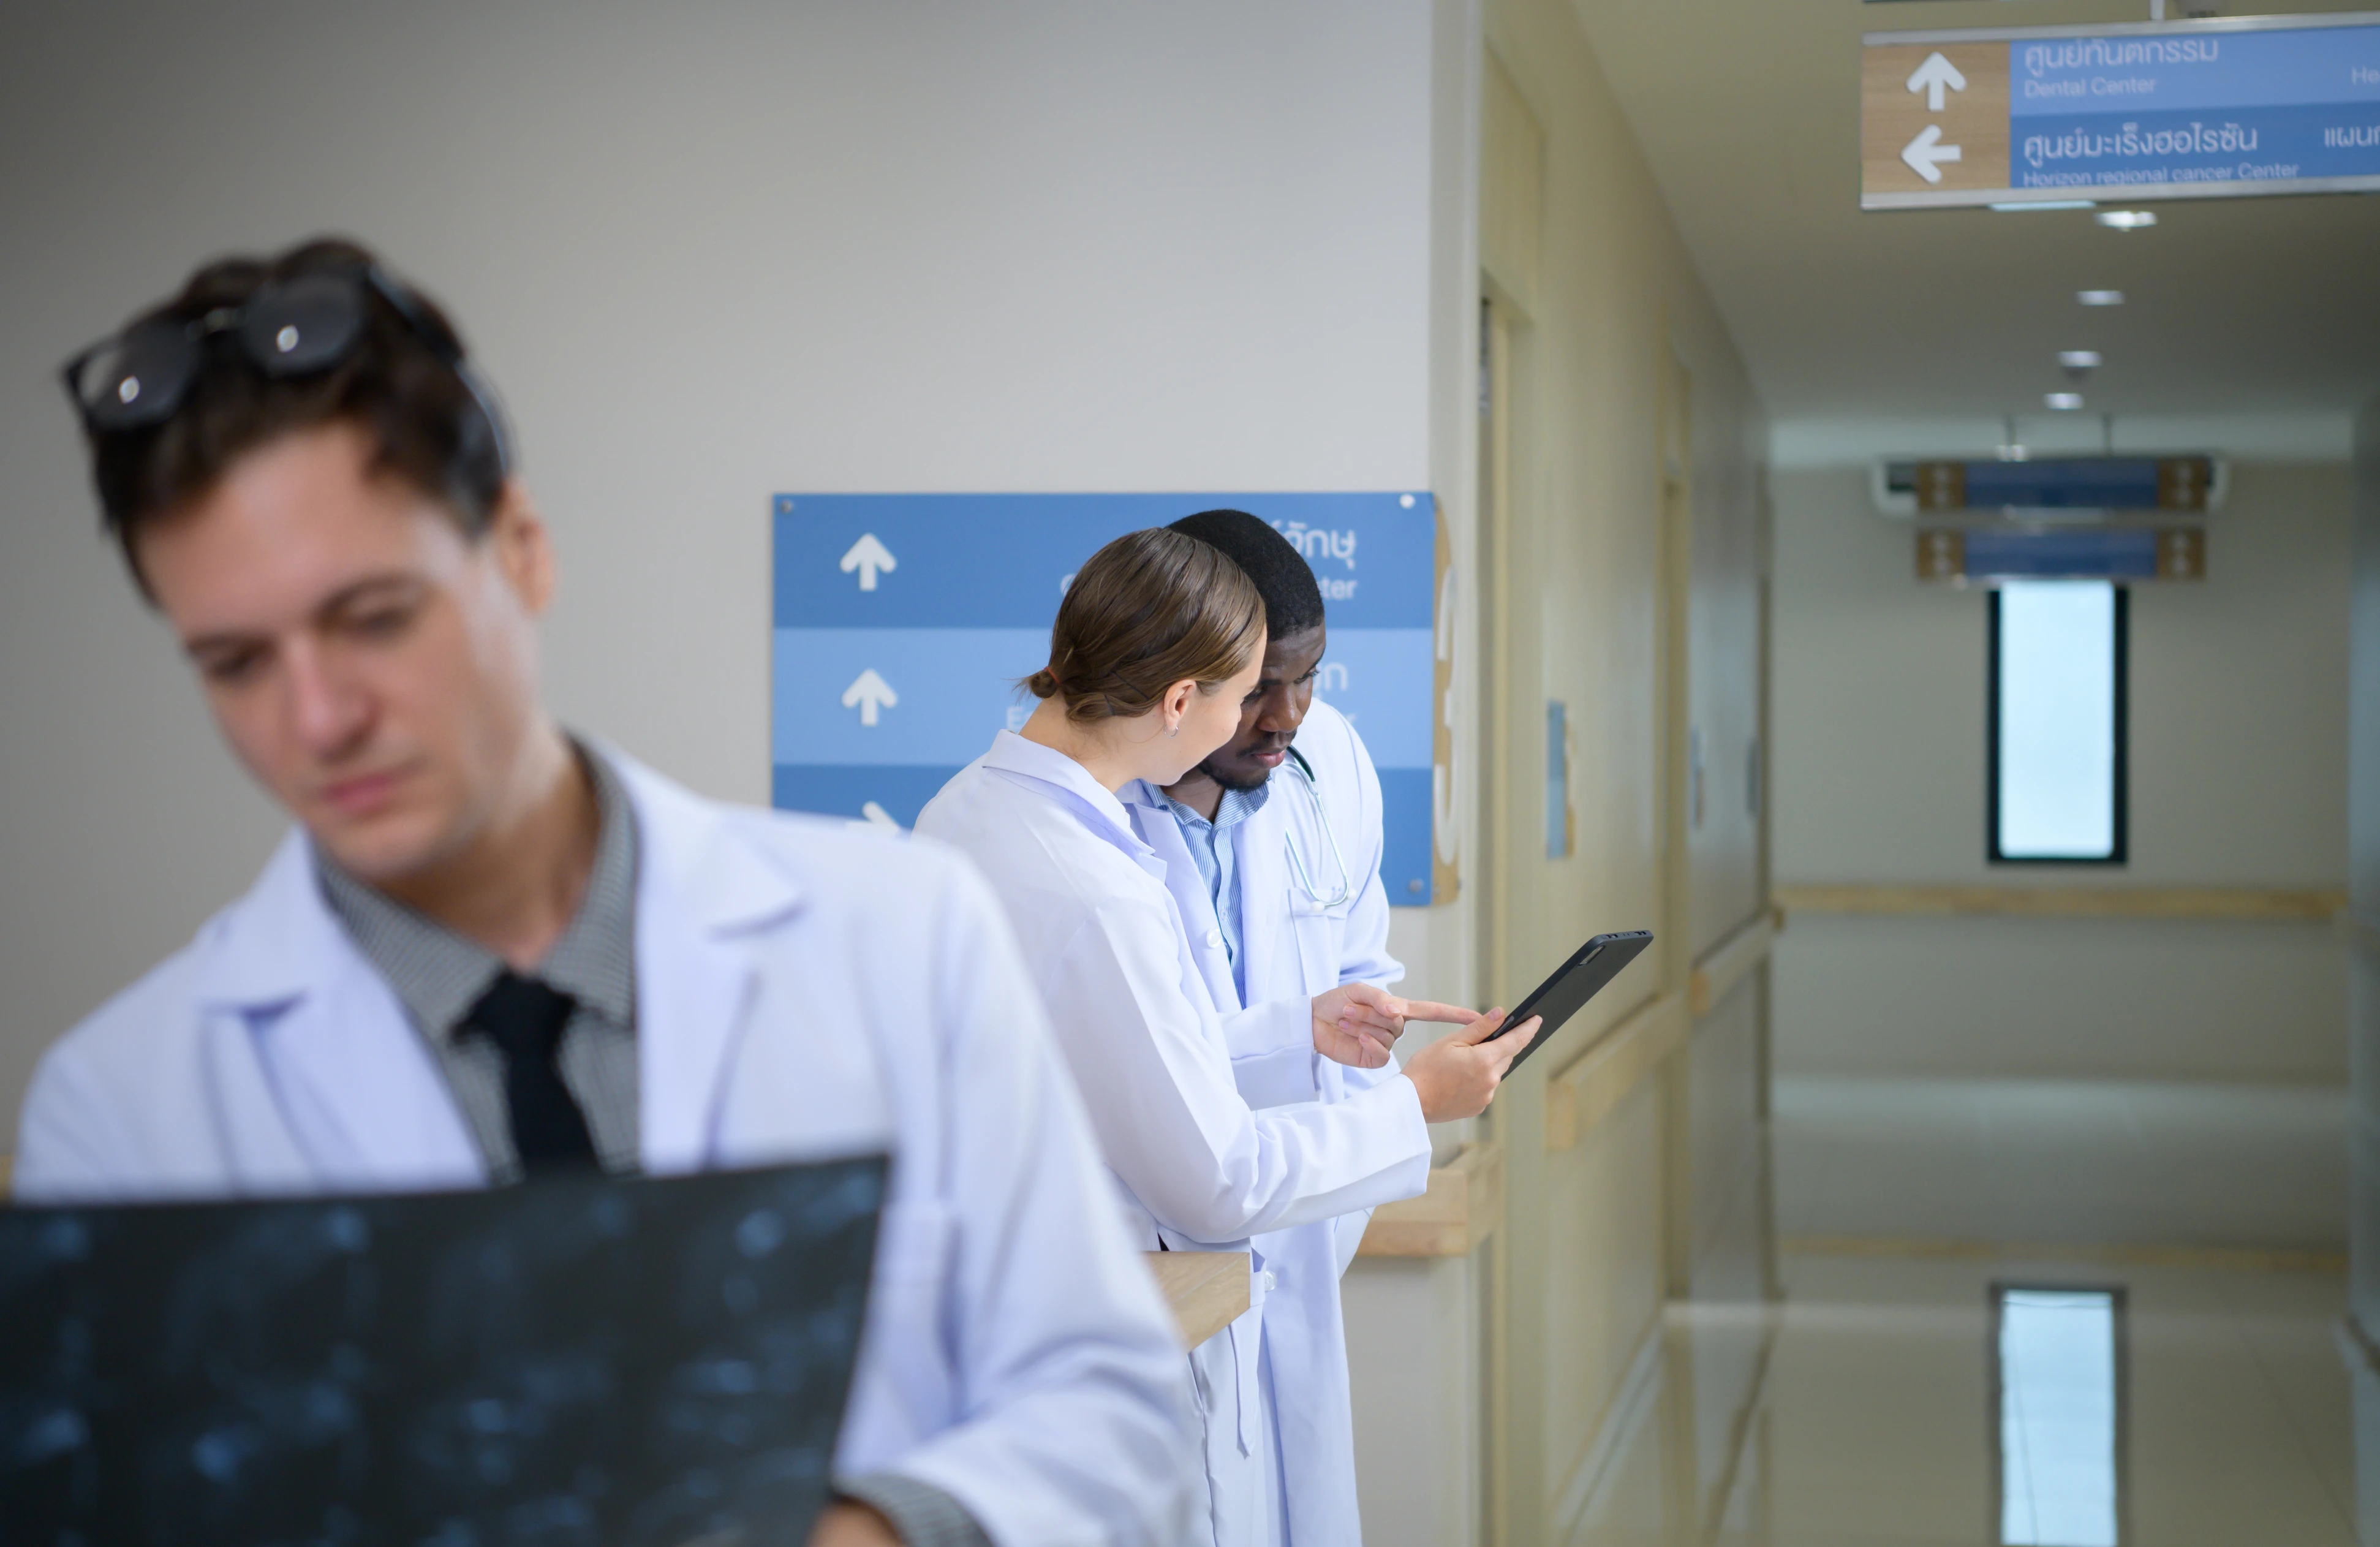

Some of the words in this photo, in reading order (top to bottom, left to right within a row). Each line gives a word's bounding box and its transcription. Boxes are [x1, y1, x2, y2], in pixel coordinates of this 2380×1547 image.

[2024, 78, 2086, 98] Dental
[2090, 76, 2156, 96] Center
[2023, 170, 2092, 187] Horizon
[2096, 165, 2168, 185] regional
[2172, 166, 2234, 183] cancer
[2238, 162, 2300, 180] Center
